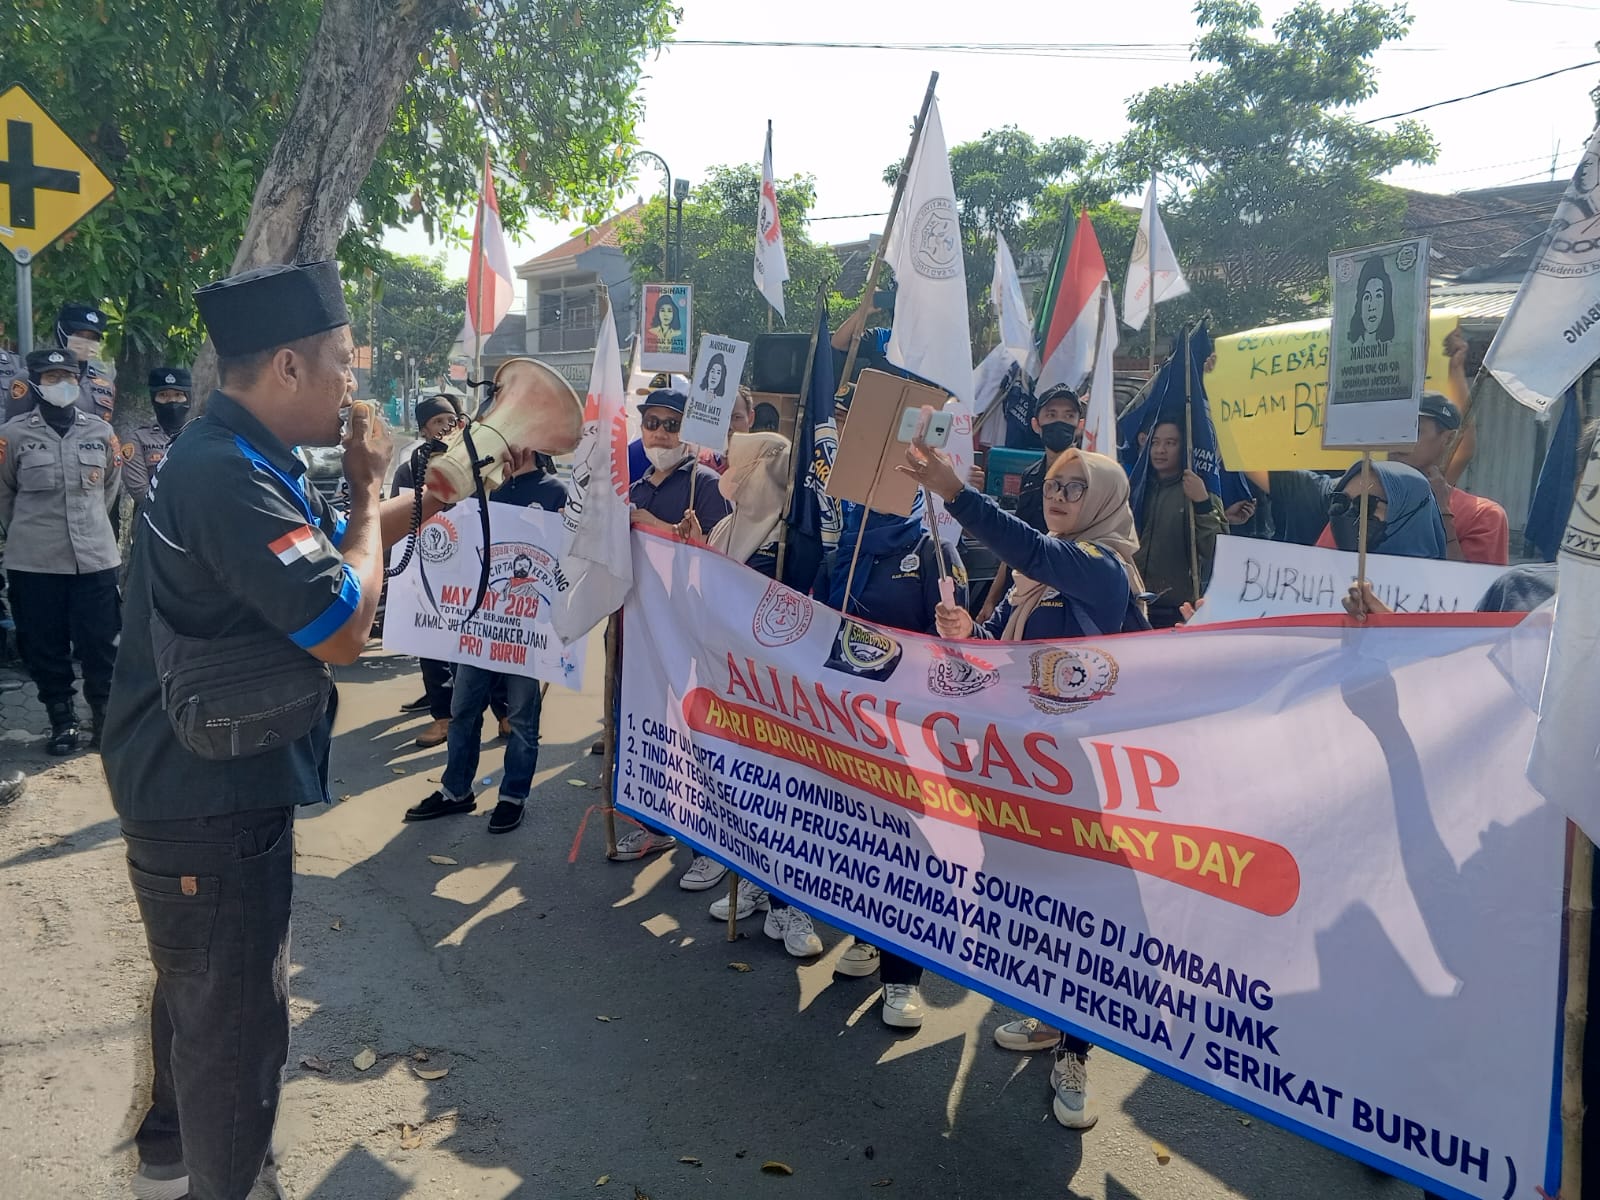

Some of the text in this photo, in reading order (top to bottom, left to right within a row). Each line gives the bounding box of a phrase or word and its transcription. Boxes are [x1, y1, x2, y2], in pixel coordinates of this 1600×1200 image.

[1220, 395, 1286, 422] DALAM
[441, 585, 539, 619] MAY AY 2025
[531, 566, 554, 590] KERJ
[1239, 558, 1335, 608] BURUH
[414, 612, 443, 630] KAWAL
[483, 611, 521, 627] BERJUANG
[459, 635, 527, 666] PRO BURUH
[726, 650, 1180, 812] ALIANSI GAS JP
[627, 713, 911, 839] 1. CABUT UU CIPTA KERJA OMNIBUS LAW
[705, 699, 749, 738] HARI
[754, 716, 824, 765] BURUH
[824, 744, 1042, 838] INTERNASIONAL
[1071, 817, 1159, 861] MAY
[1171, 834, 1256, 889] DAY
[627, 736, 1274, 1011] 2. TINDAK TEGAS SELURUH PERUSAHAAN OUT SOURCING DI JOMBANG
[625, 759, 1281, 1056] 3. TINDAK TEGAS PERUSAHAAN YANG MEMBAYAR UPAH DIBAWAH UMK
[623, 783, 635, 801] 4.
[637, 787, 676, 822] TOLAK
[678, 808, 717, 843] UNION
[719, 831, 771, 876] BUSTING
[783, 867, 957, 954] PEMBERANGUSAN
[958, 936, 1057, 997] SERIKAT
[1060, 979, 1172, 1051] PEKERJA
[1204, 1041, 1343, 1120] SERIKAT
[1352, 1097, 1490, 1183] BURUH
